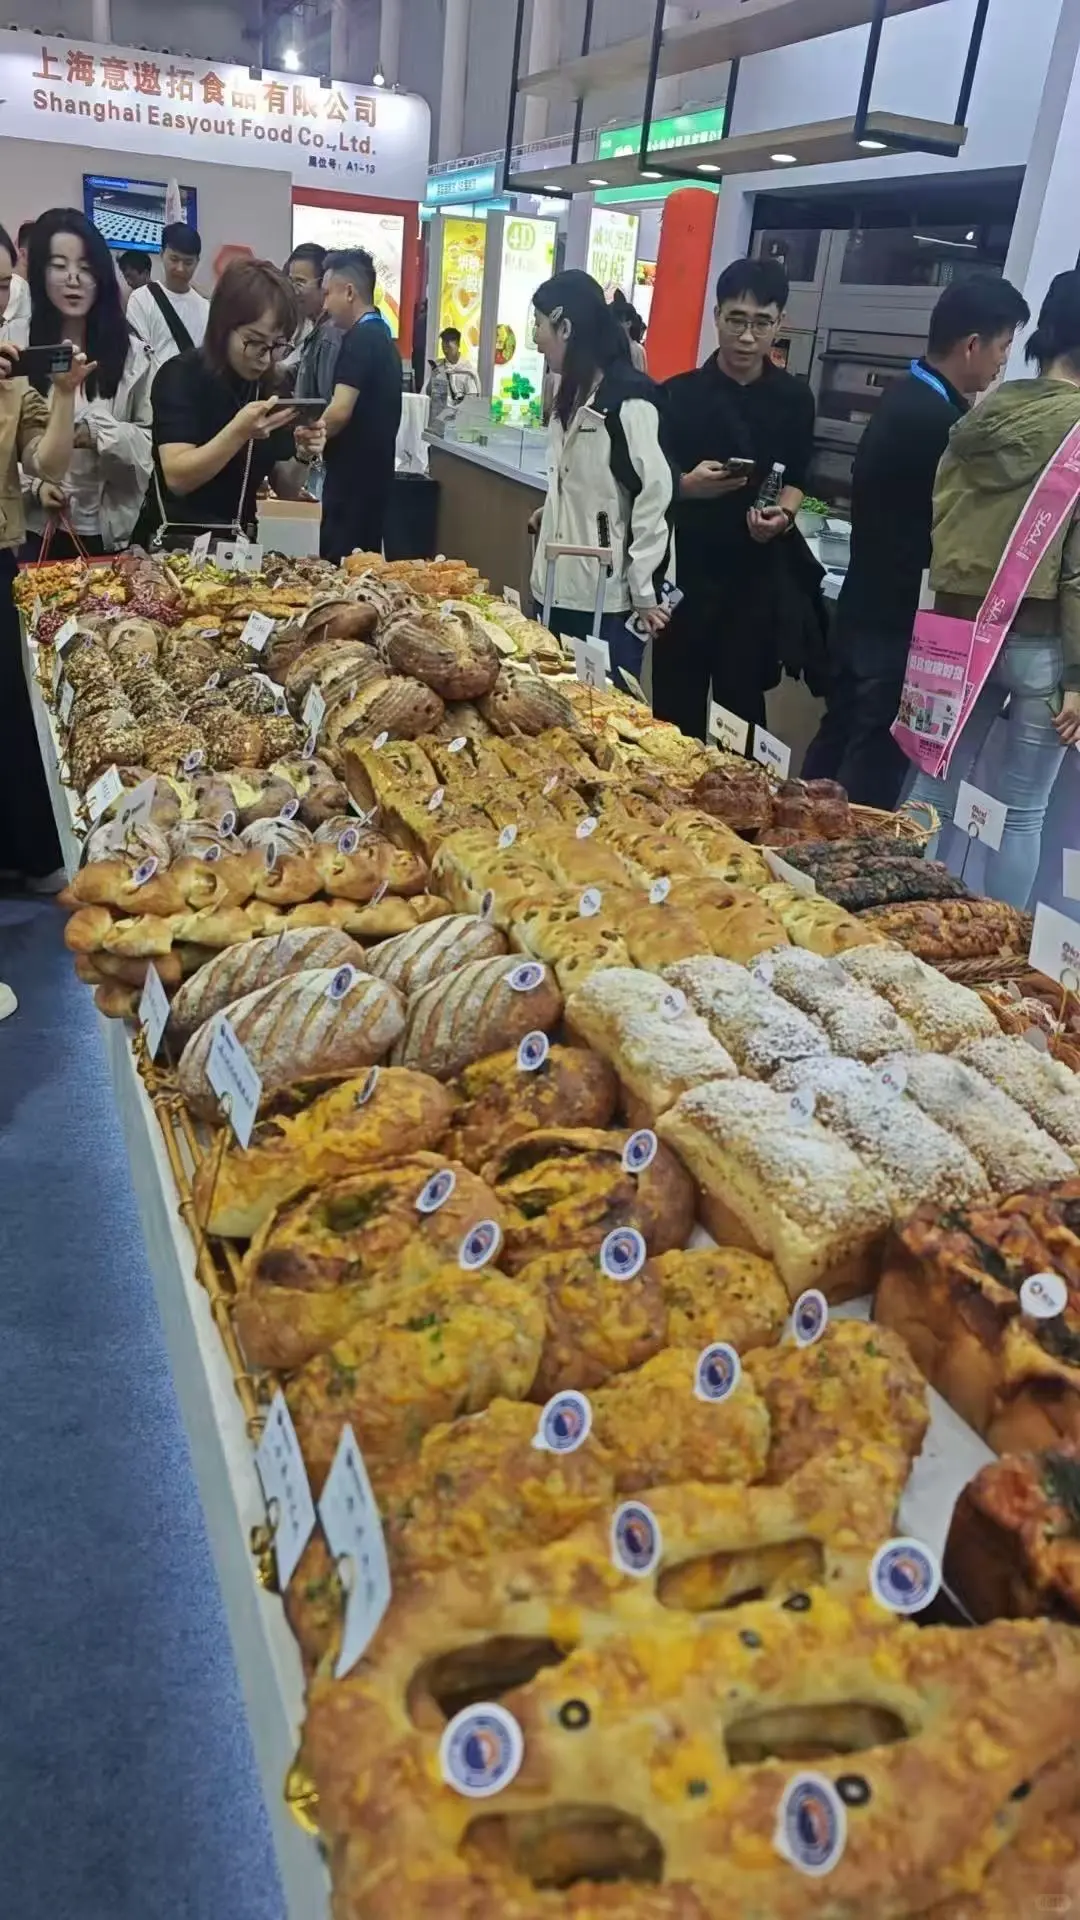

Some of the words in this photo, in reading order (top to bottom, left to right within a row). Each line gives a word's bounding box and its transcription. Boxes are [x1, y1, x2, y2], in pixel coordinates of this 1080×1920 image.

[32, 46, 376, 127] 上海意遨拓食品有限公司
[33, 89, 141, 122] Shanghai
[148, 105, 235, 135] Easyout
[241, 119, 292, 143] Food
[346, 161, 375, 174] A1-13
